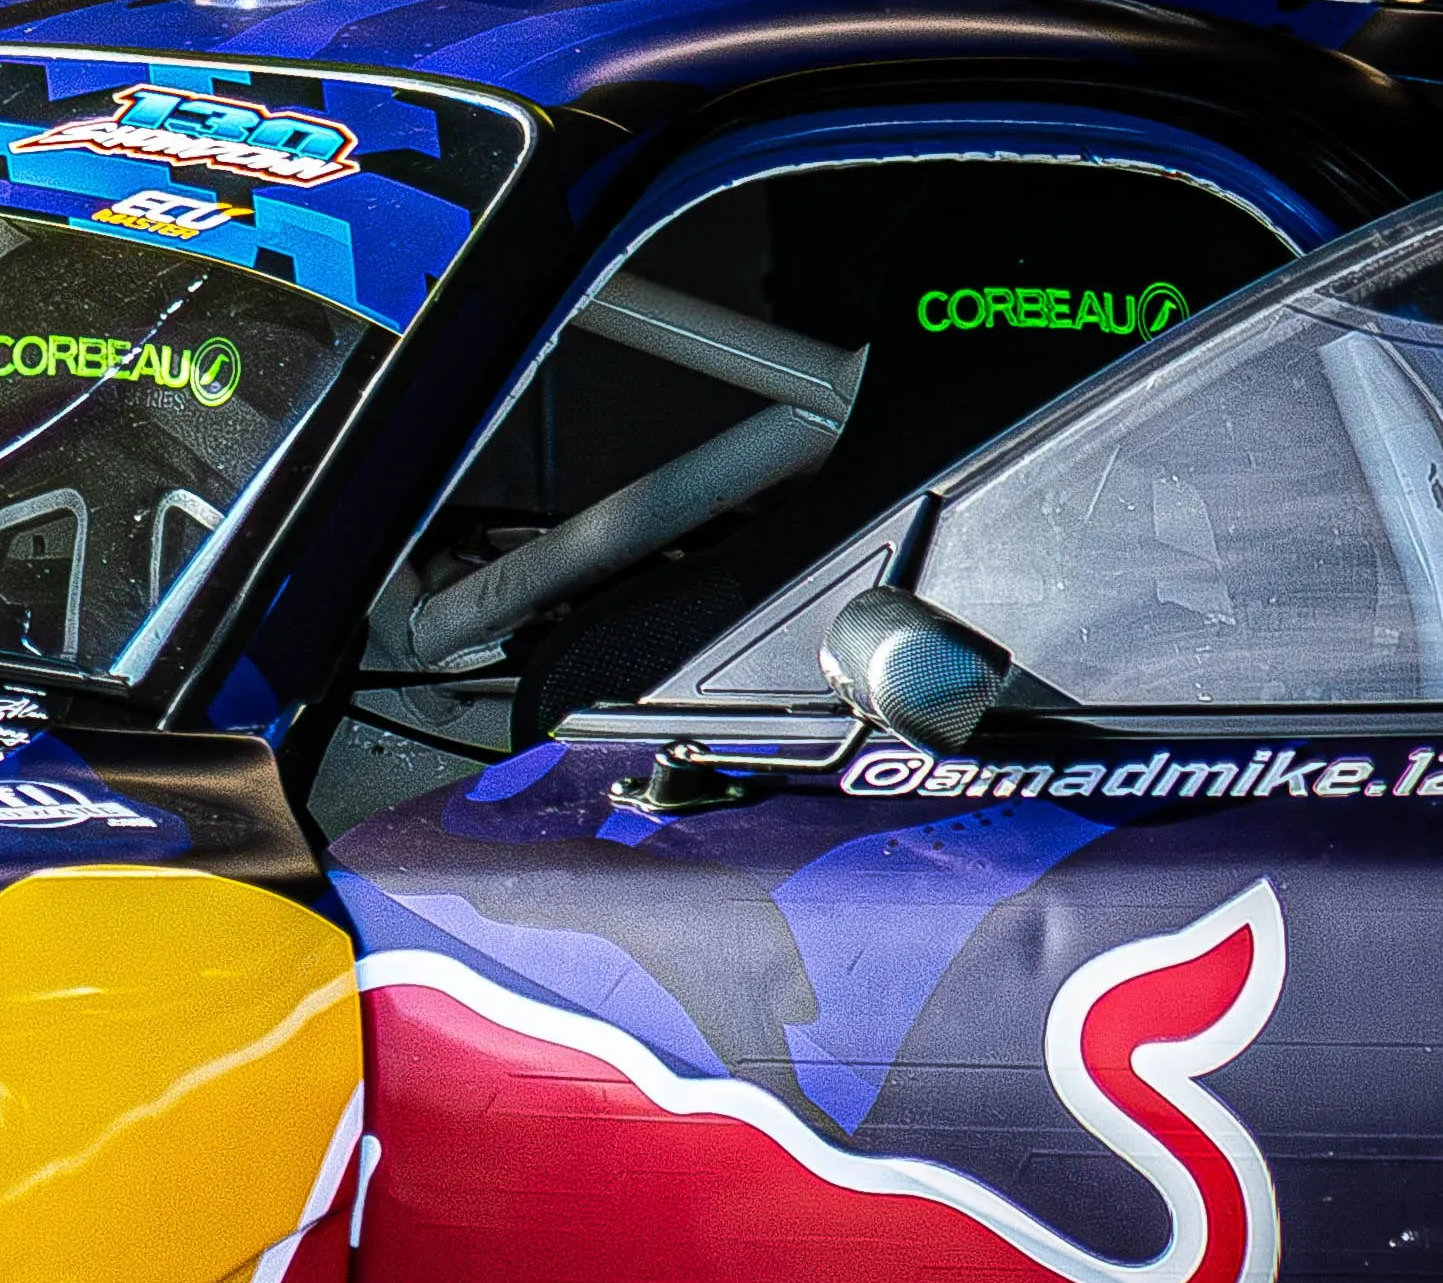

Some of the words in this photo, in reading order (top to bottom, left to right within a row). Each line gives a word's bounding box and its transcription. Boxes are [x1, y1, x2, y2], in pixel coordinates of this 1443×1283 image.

[122, 91, 344, 161] 130
[37, 122, 343, 178] SHOWDOWN
[91, 208, 201, 240] MASTER
[112, 190, 234, 231] ECU
[918, 287, 1136, 334] CORBEAU
